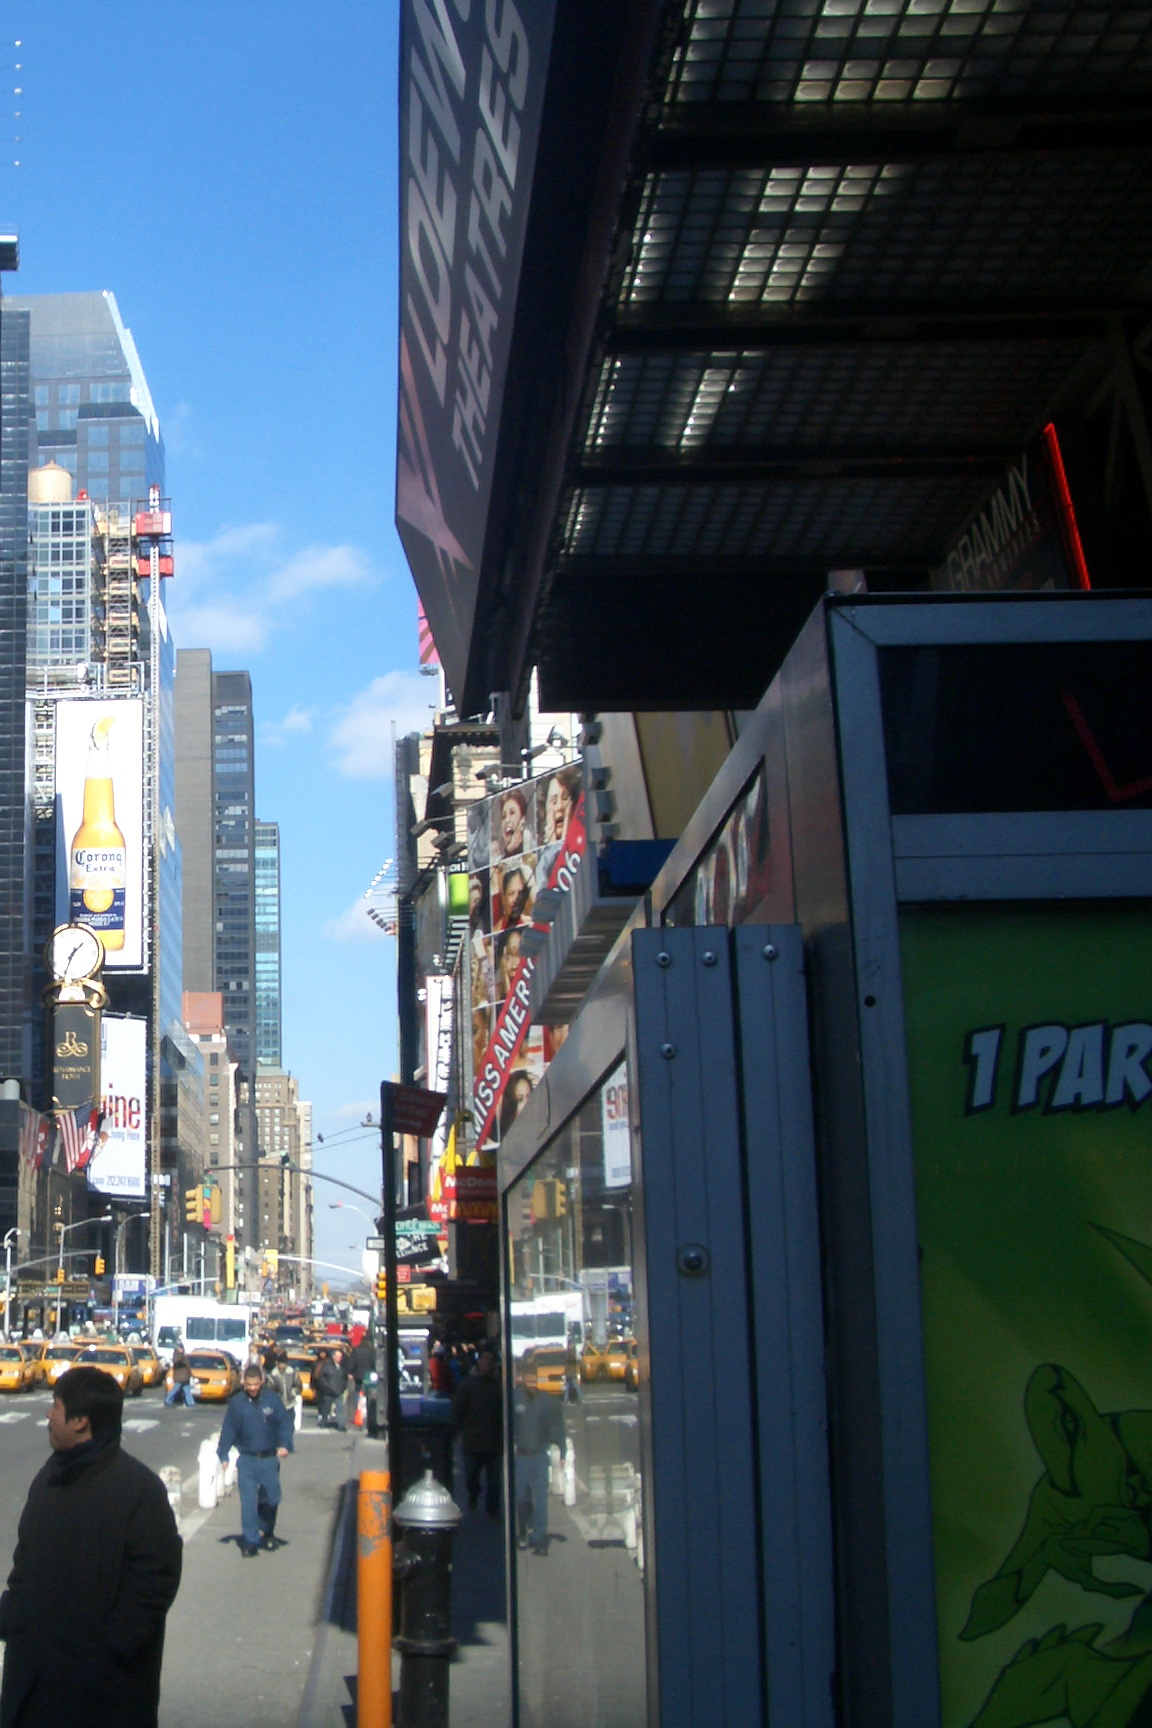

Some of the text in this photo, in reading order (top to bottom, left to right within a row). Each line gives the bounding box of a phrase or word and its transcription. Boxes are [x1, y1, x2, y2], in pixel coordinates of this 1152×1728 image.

[407, 0, 470, 408] LOEW
[452, 0, 529, 491] THEATRES
[75, 850, 122, 866] Corona
[85, 864, 115, 873] Extra
[473, 957, 537, 1134] MISS AMERI
